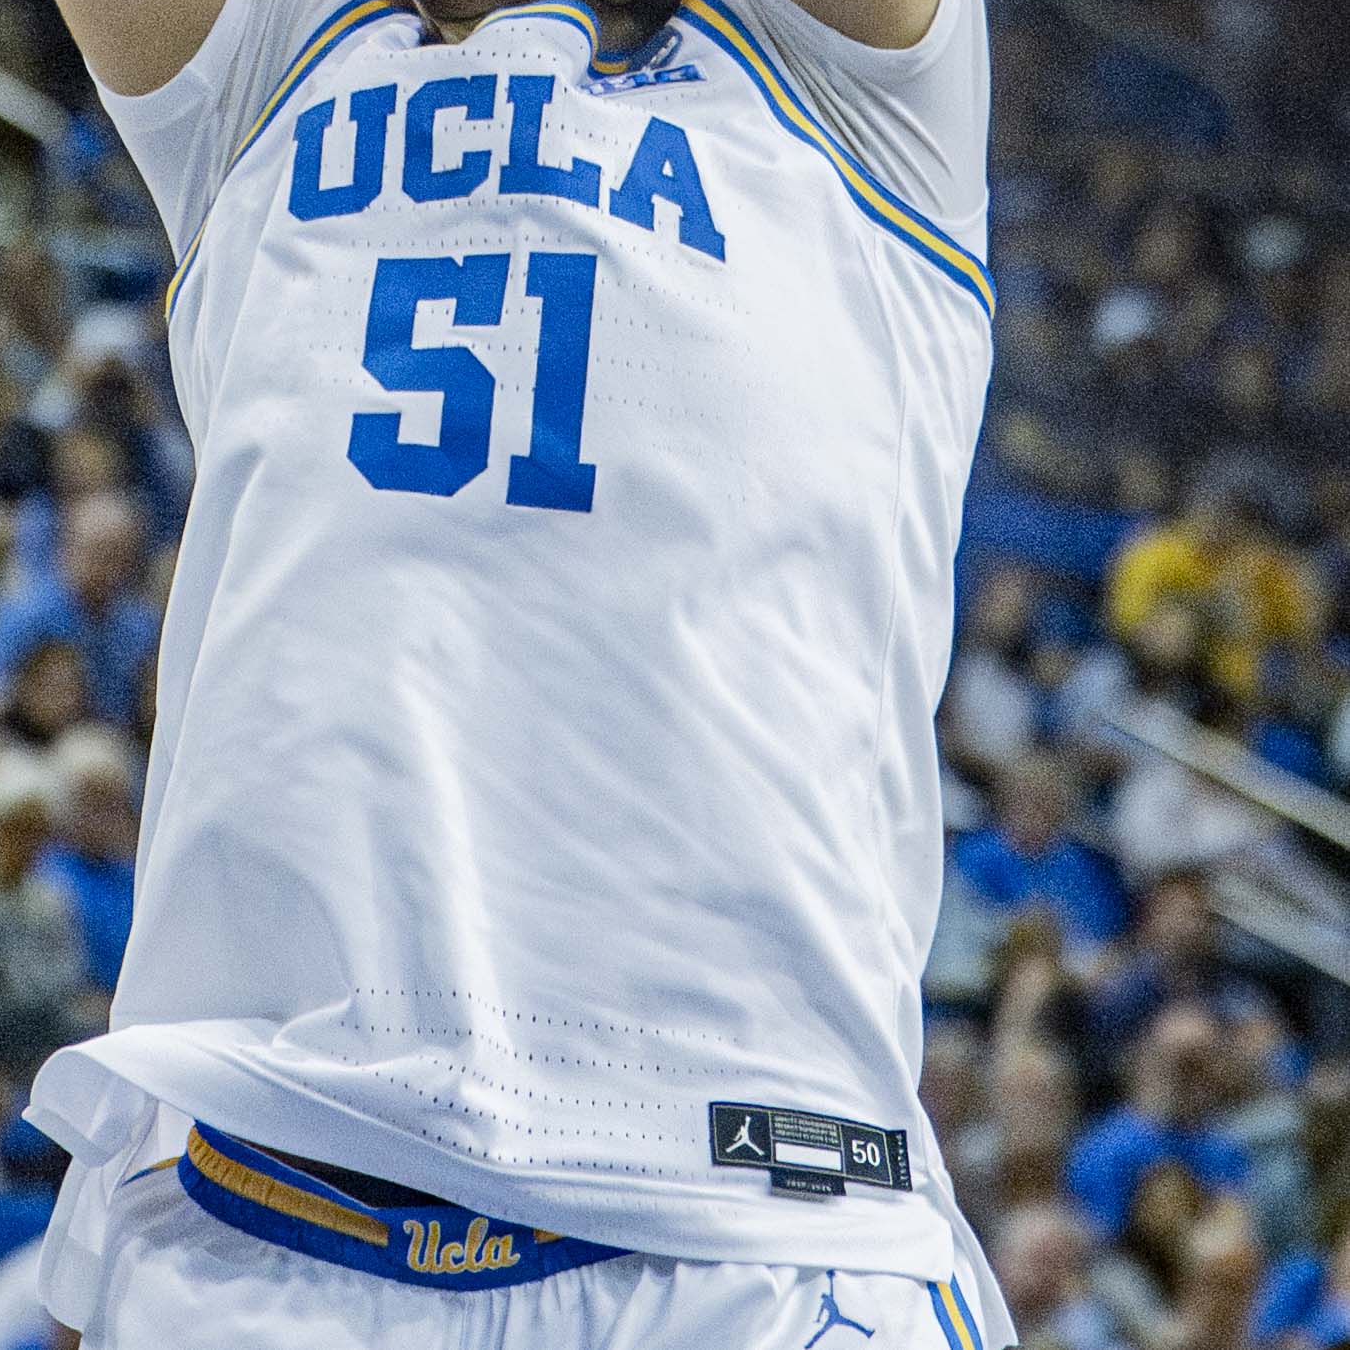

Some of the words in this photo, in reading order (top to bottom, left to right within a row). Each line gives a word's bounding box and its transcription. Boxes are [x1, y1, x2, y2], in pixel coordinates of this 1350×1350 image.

[288, 73, 726, 263] UCLA
[346, 251, 598, 513] 51
[851, 1139, 881, 1167] 50
[402, 1216, 522, 1275] Ucla
